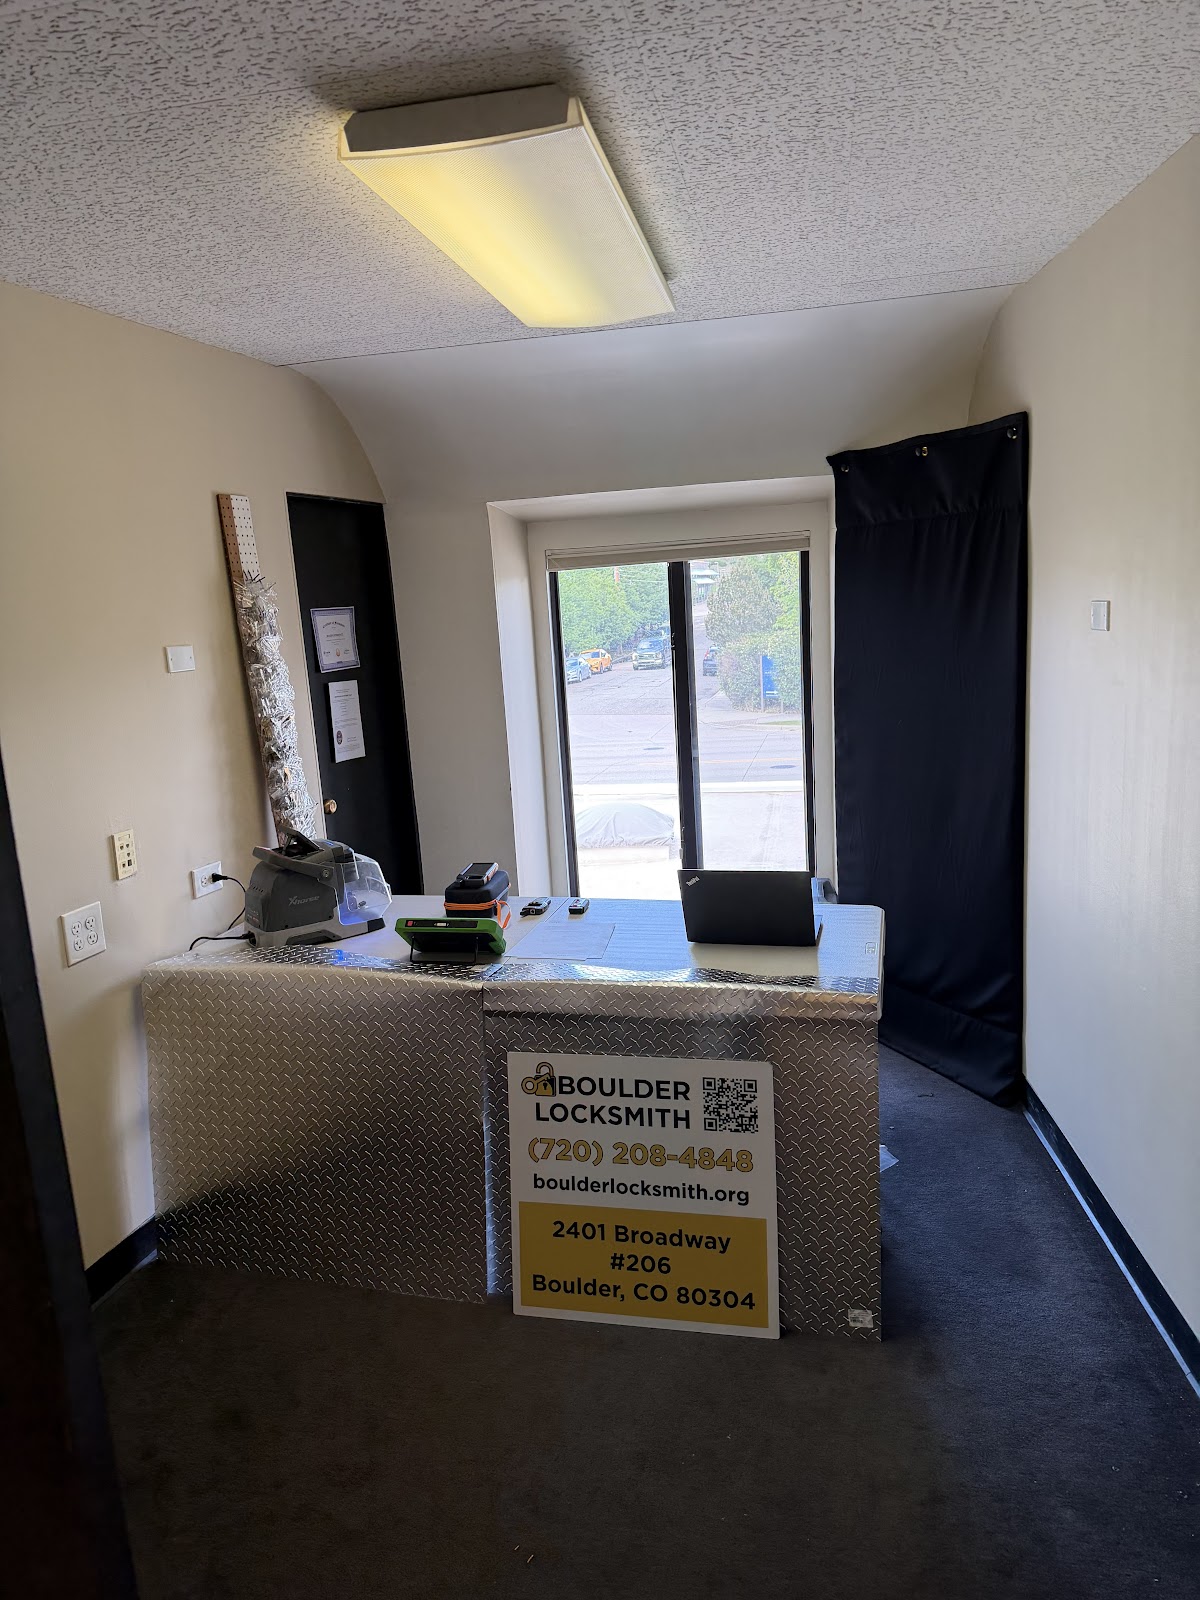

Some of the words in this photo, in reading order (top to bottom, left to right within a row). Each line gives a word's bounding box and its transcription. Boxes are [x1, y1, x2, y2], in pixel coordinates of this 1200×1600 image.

[558, 1075, 690, 1101] BOULDER
[535, 1102, 691, 1129] LOCKSMITH
[528, 1137, 604, 1167] (720)
[612, 1142, 754, 1172] 208-4848
[533, 1173, 750, 1206] boulderlocksmith.org
[552, 1220, 605, 1241] 2401
[615, 1225, 731, 1253] Broadway
[610, 1253, 671, 1274] #206
[532, 1274, 625, 1302] Boulder,
[634, 1283, 668, 1302] CO
[676, 1287, 756, 1309] 80304
